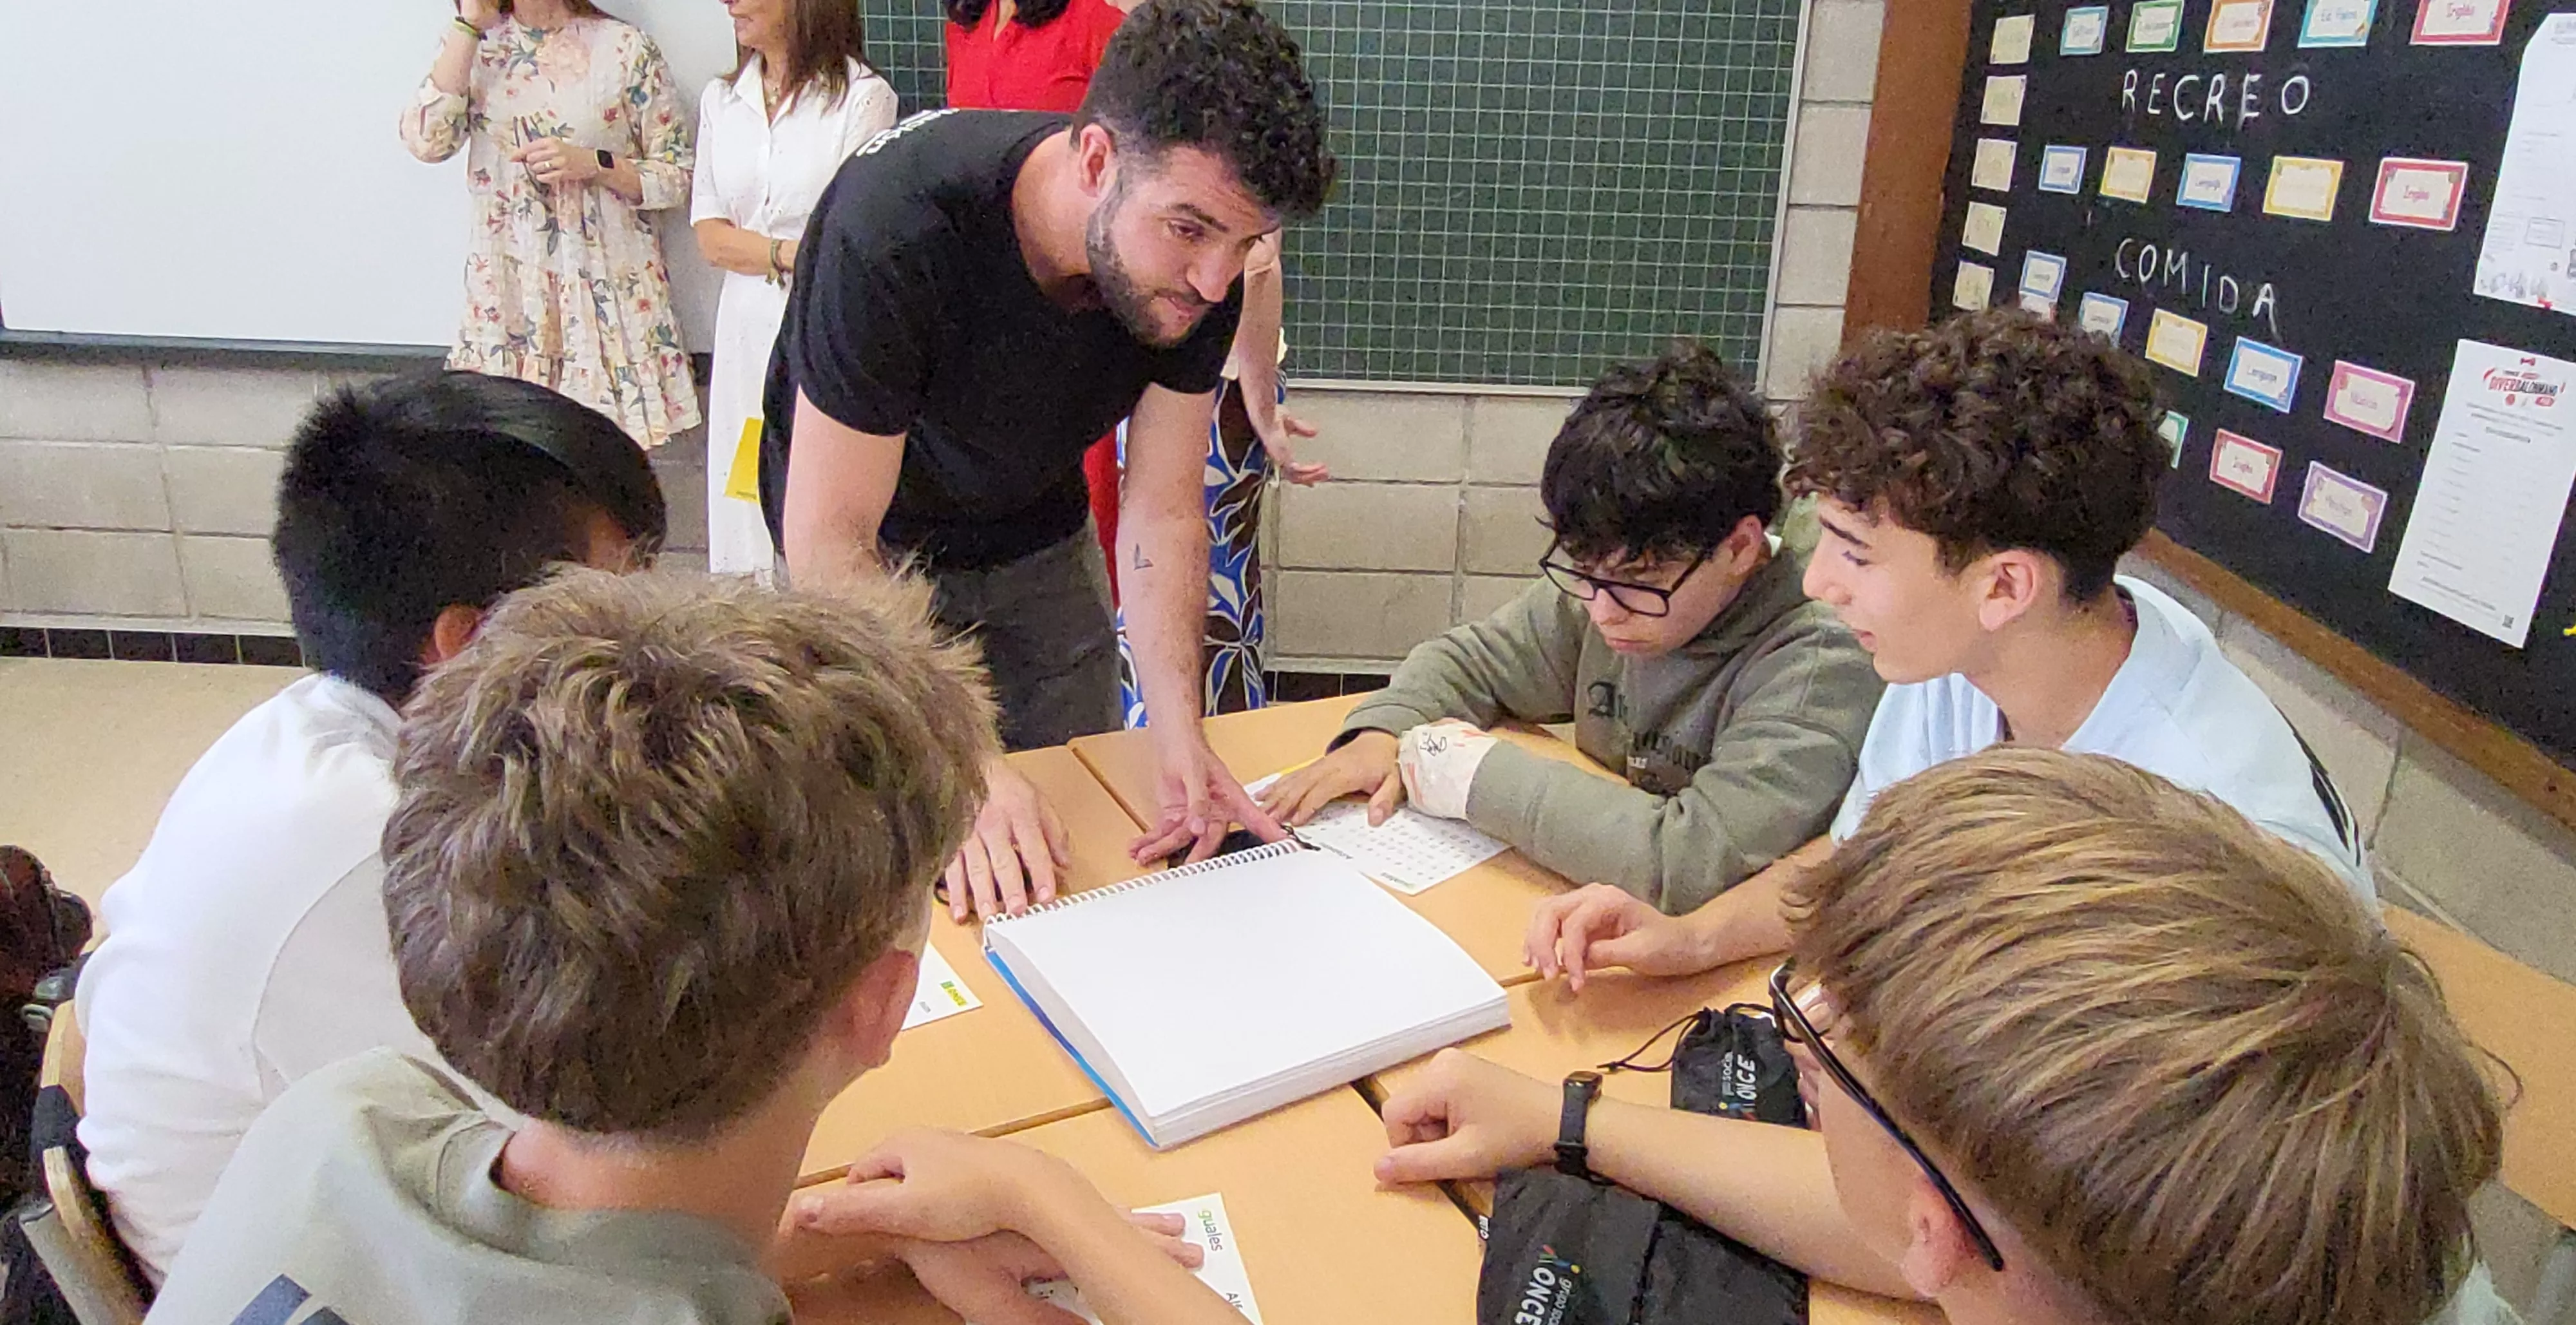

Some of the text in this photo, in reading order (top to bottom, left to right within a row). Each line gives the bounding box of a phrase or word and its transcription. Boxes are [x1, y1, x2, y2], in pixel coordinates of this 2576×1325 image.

[2121, 69, 2309, 128] RECREO
[2116, 238, 2280, 338] COMIDA
[1736, 1054, 1757, 1100] ONCE
[1197, 1210, 1224, 1252] guales
[1514, 1267, 1555, 1325] ONCE
